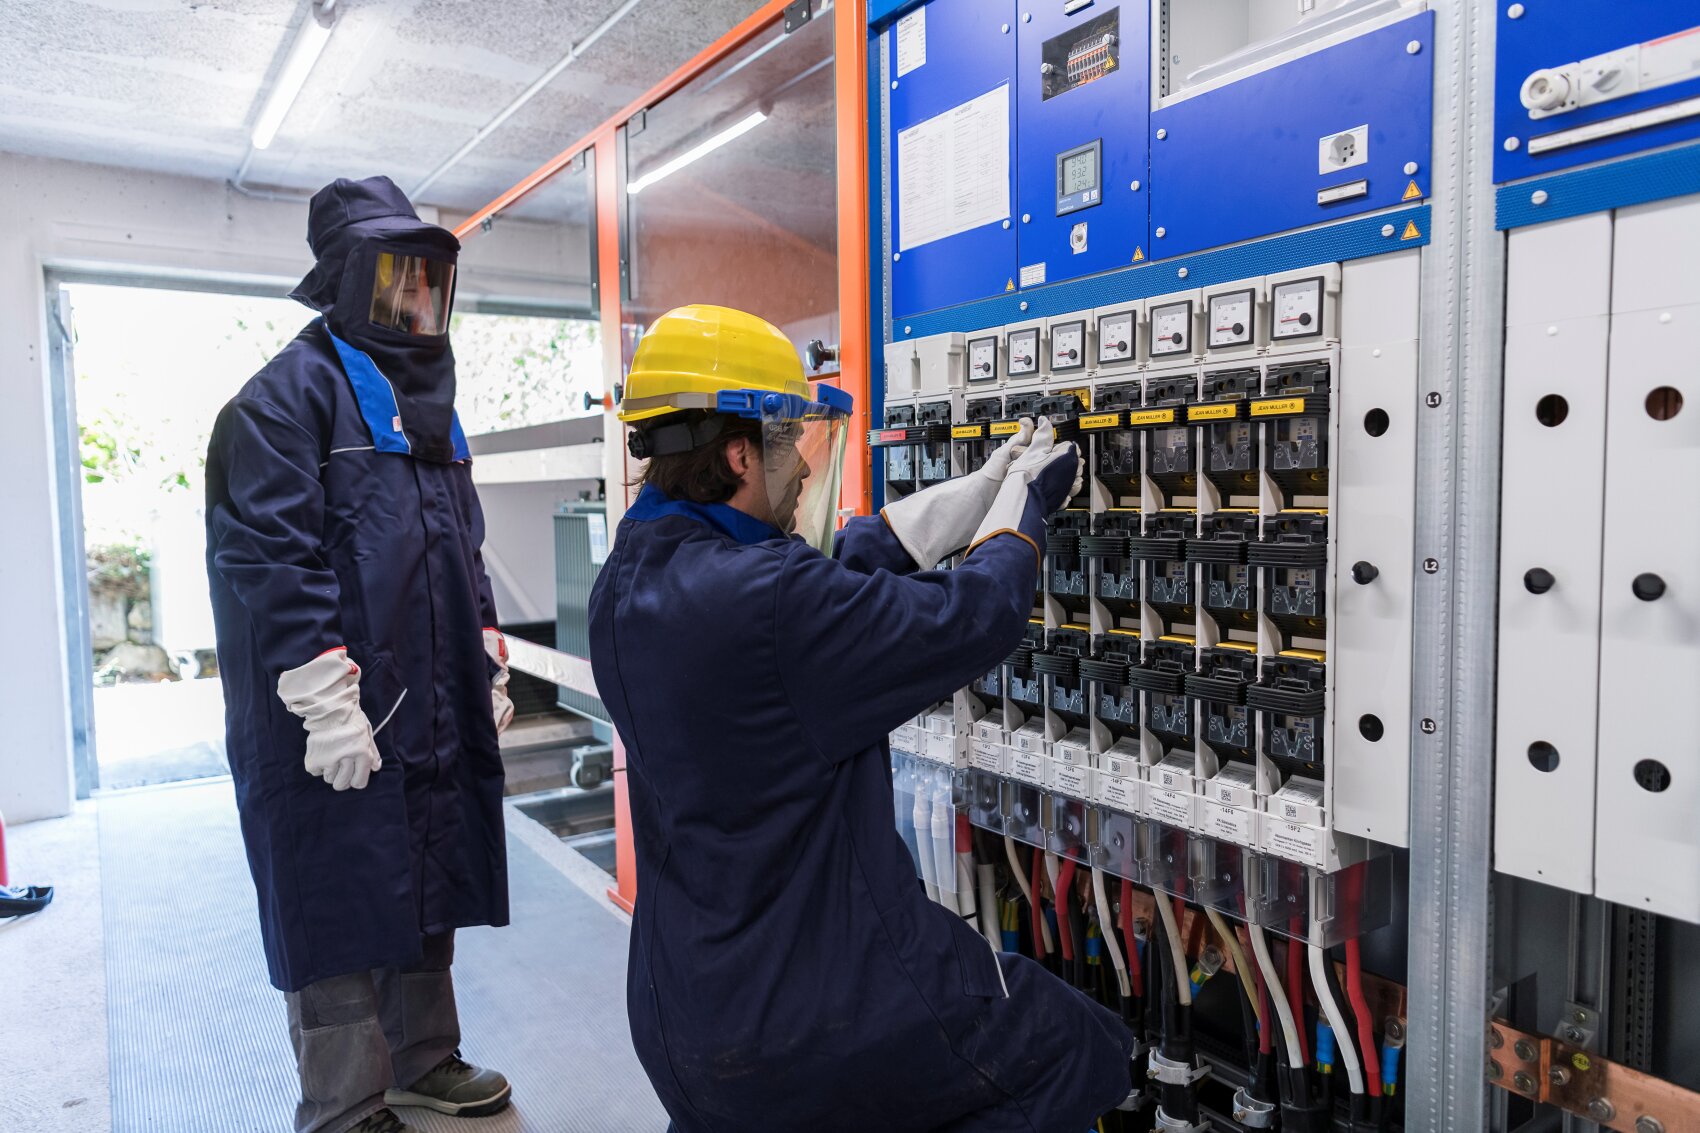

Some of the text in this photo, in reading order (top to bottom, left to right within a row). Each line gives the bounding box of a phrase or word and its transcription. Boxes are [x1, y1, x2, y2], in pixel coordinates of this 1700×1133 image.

[1427, 394, 1440, 405] L1
[1424, 561, 1438, 571] L2
[1421, 720, 1435, 731] L3
